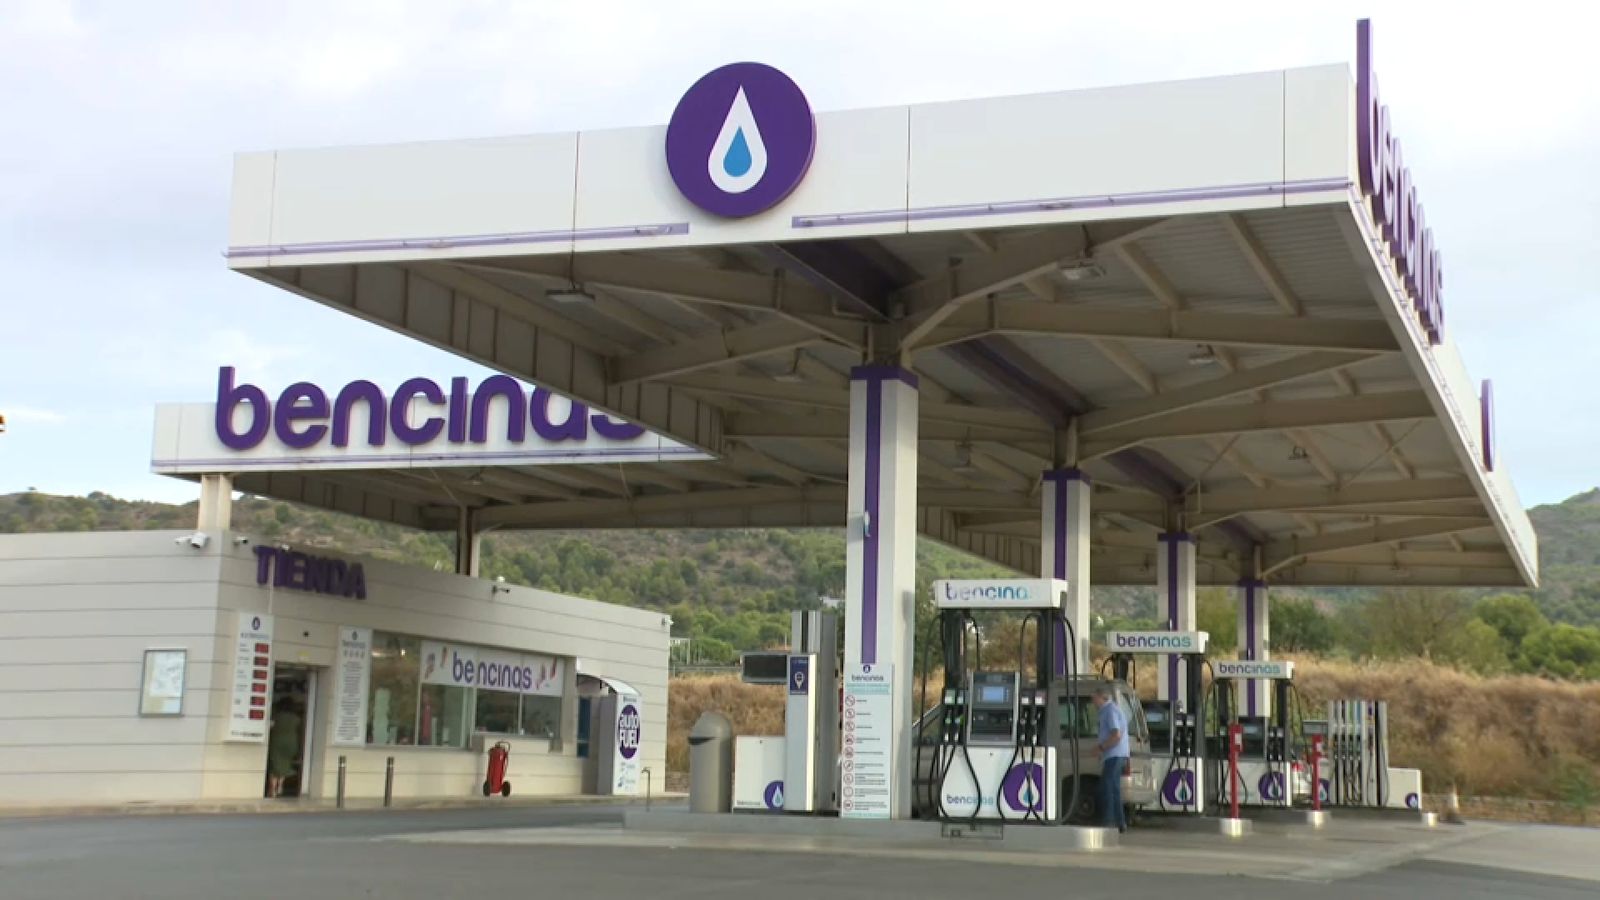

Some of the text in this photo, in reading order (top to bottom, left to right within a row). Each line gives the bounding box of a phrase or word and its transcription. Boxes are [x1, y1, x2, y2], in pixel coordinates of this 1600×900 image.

[252, 545, 366, 599] TIENDA
[945, 582, 1028, 600] bencina
[1117, 634, 1191, 648] bencinas
[453, 652, 532, 689] bencinas
[1219, 663, 1280, 674] bencinas
[620, 711, 640, 730] auto
